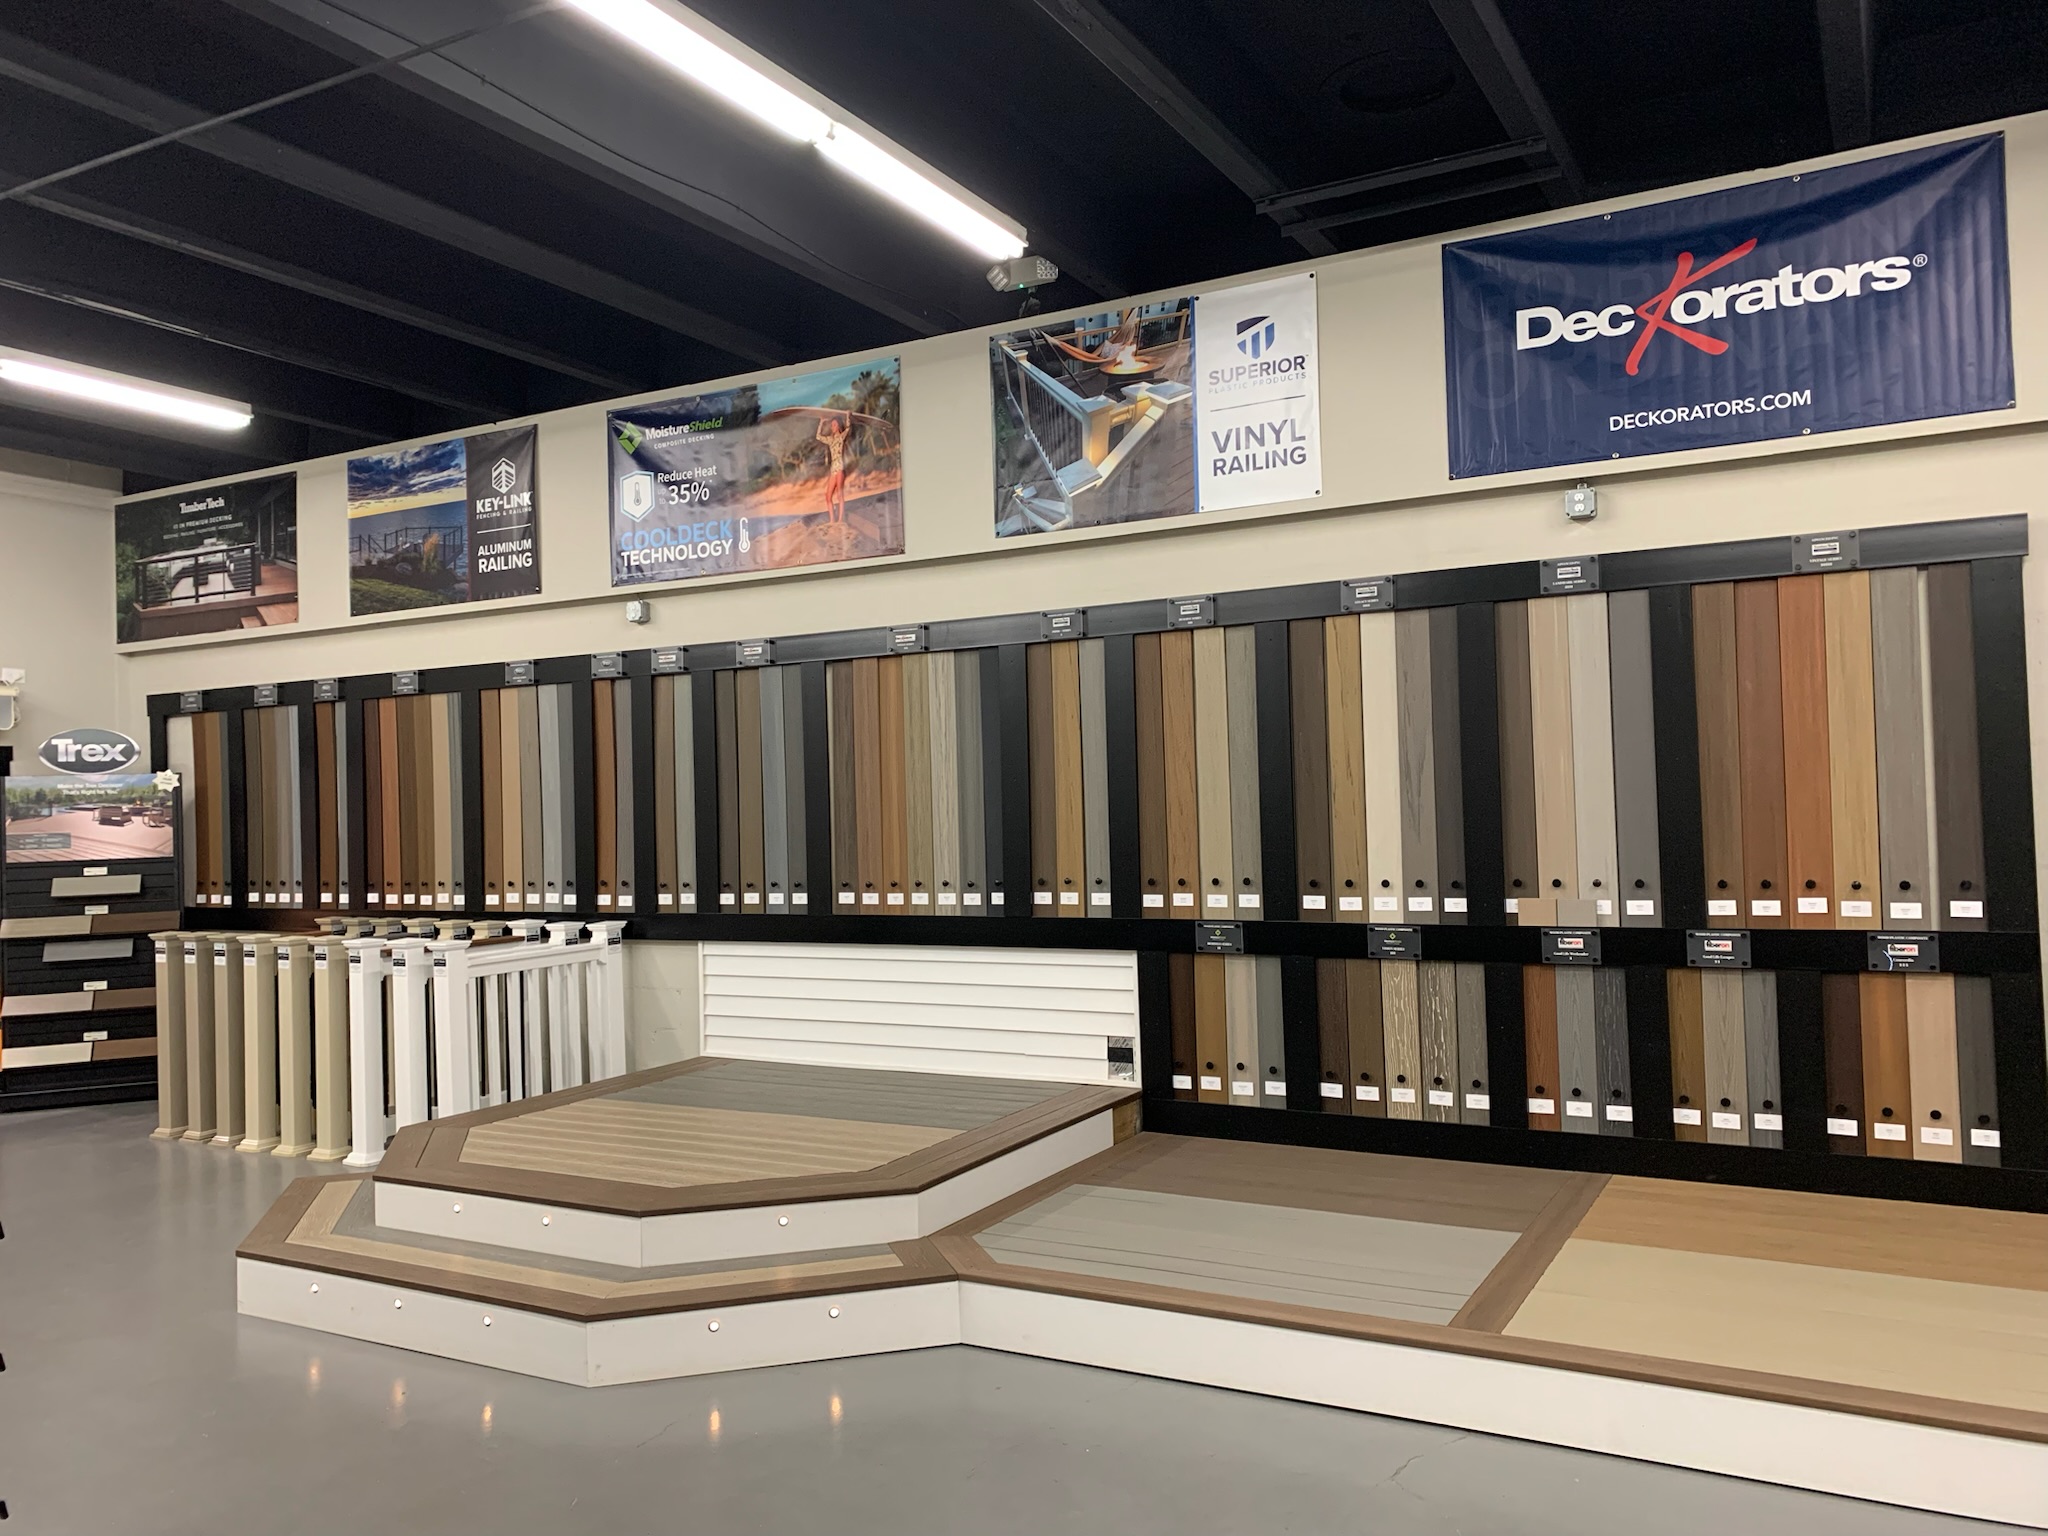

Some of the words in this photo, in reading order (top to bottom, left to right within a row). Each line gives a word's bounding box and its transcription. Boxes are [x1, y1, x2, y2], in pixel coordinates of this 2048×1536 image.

[1209, 355, 1306, 386] SUPERIOR
[1253, 372, 1306, 387] PRODUCTS
[1609, 390, 1811, 432] DECKORATORS.COM
[645, 417, 723, 440] MoistureShield
[1211, 418, 1306, 453] VINYL
[654, 439, 686, 449] COMPOSITE
[688, 434, 714, 443] DECKING
[1213, 446, 1306, 476] RAILING
[657, 470, 692, 483] Reduce
[695, 465, 717, 478] Heat
[476, 492, 531, 513] KEY-LINK
[509, 506, 532, 515] RAILING
[621, 519, 732, 550] COOLDECK
[478, 538, 531, 556] ALUMINUM
[621, 539, 732, 566] TECHNOLOGY
[478, 552, 532, 573] RAILING
[51, 739, 128, 762] Trex
